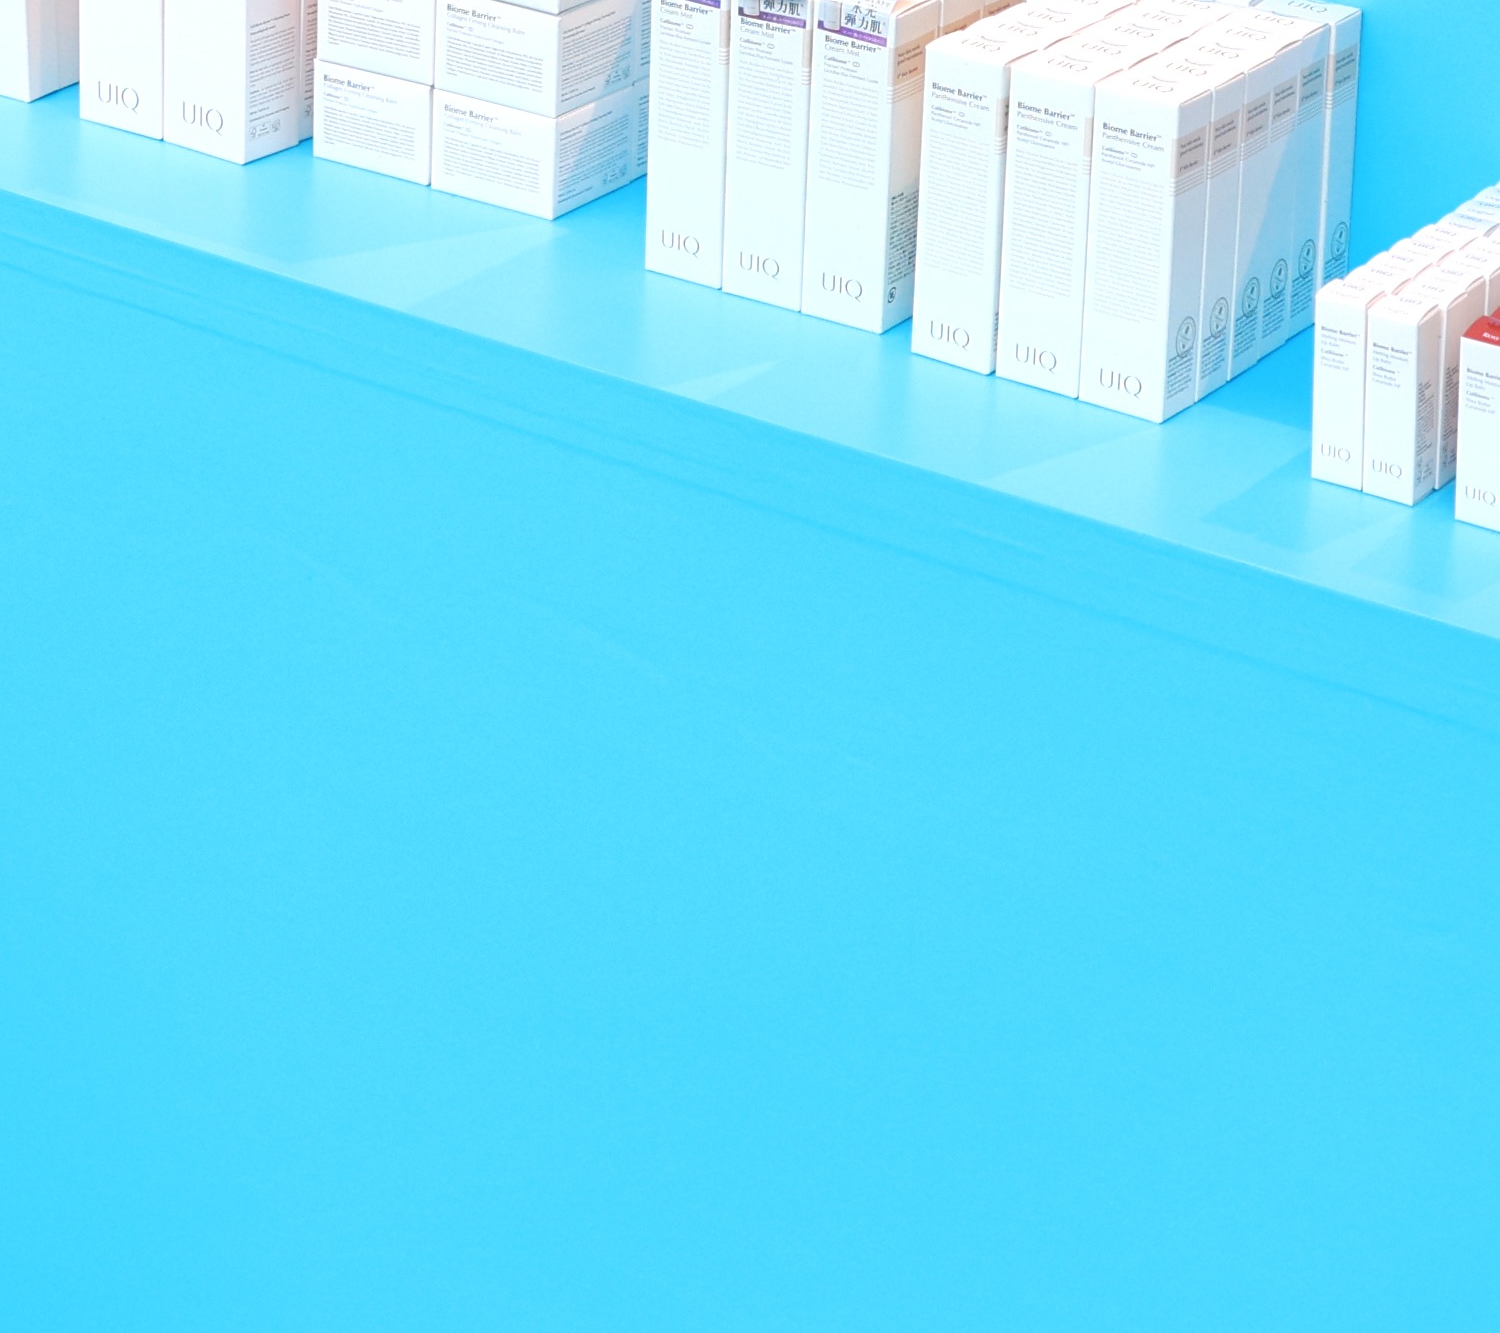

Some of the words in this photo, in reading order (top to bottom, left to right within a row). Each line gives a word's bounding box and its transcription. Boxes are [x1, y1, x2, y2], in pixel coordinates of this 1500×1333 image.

[740, 16, 763, 30] Biome
[824, 32, 849, 47] Biome
[97, 79, 139, 114] UIQ
[931, 81, 955, 94] Biome
[182, 100, 224, 137] UIQ
[1017, 101, 1042, 115] Biome
[1102, 121, 1128, 135] Biome
[661, 228, 700, 259] UIQ
[739, 250, 781, 280] UIQ
[821, 271, 864, 299] UIQ
[930, 319, 970, 351] UIQ
[1015, 342, 1058, 374] UIQ
[1099, 367, 1142, 398] UIQ
[1320, 442, 1351, 464] UIQ
[1371, 459, 1403, 480] UIQ
[1464, 484, 1496, 508] UIQ
